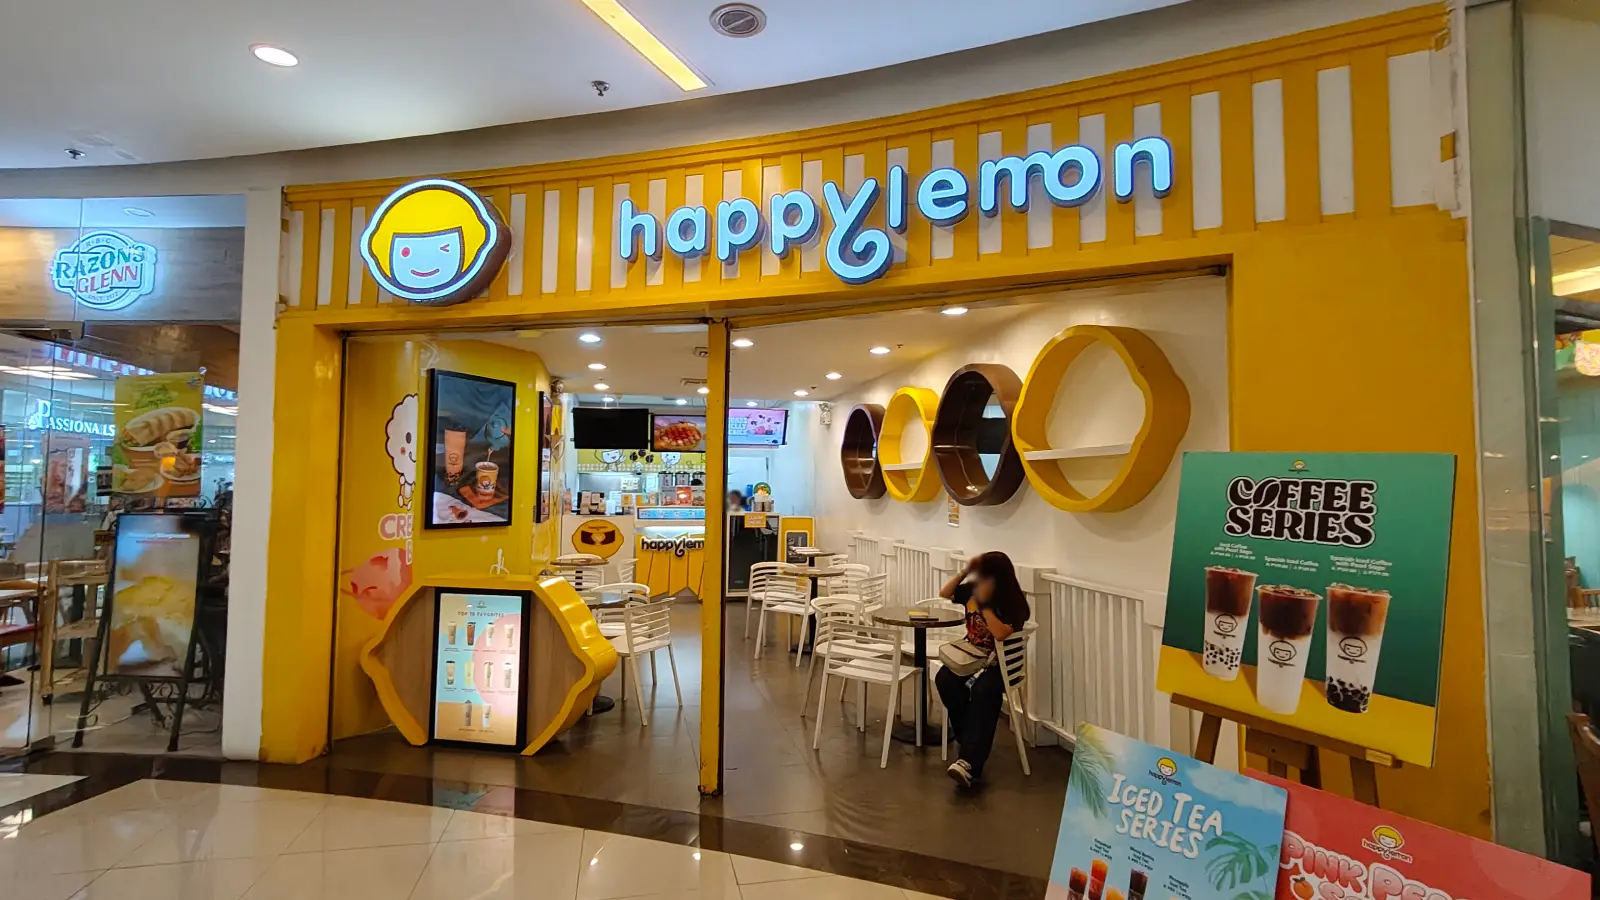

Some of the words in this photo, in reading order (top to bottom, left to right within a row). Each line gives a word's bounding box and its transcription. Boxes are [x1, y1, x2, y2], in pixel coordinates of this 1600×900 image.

[55, 244, 145, 279] RAZON'S
[77, 265, 138, 293] GLENN
[1228, 477, 1377, 515] COFFEE
[1225, 506, 1375, 547] SERIES
[1106, 773, 1163, 817] ICED
[1173, 792, 1222, 837] TEA
[1115, 808, 1204, 859] SERIES
[1281, 832, 1364, 893] PINK
